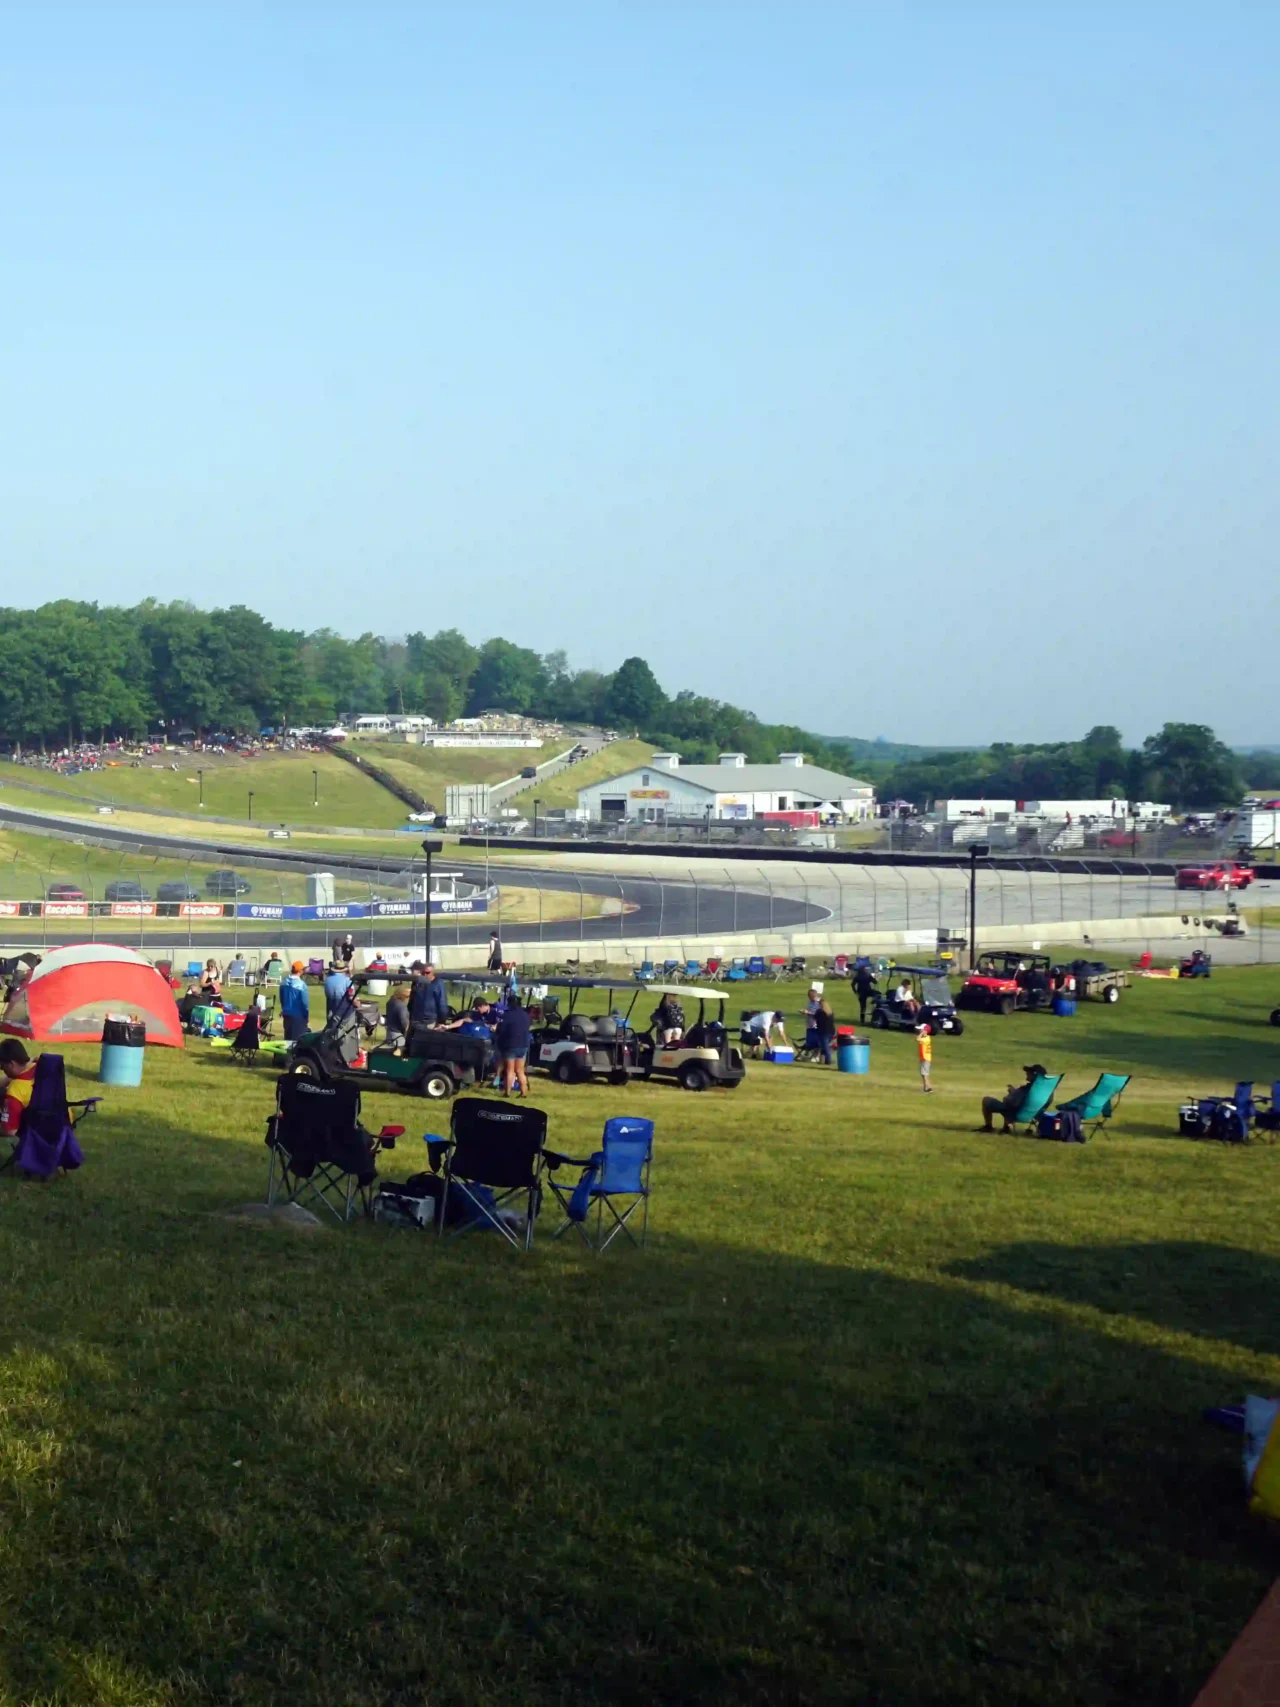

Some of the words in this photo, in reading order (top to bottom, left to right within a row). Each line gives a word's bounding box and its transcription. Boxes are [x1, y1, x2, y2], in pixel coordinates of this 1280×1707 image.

[386, 904, 411, 912] YAMAHA
[449, 901, 473, 909] YAMAHA
[44, 904, 85, 915] RaceQuip
[258, 907, 283, 915] YAMAHA
[325, 907, 349, 915] YAMAHA
